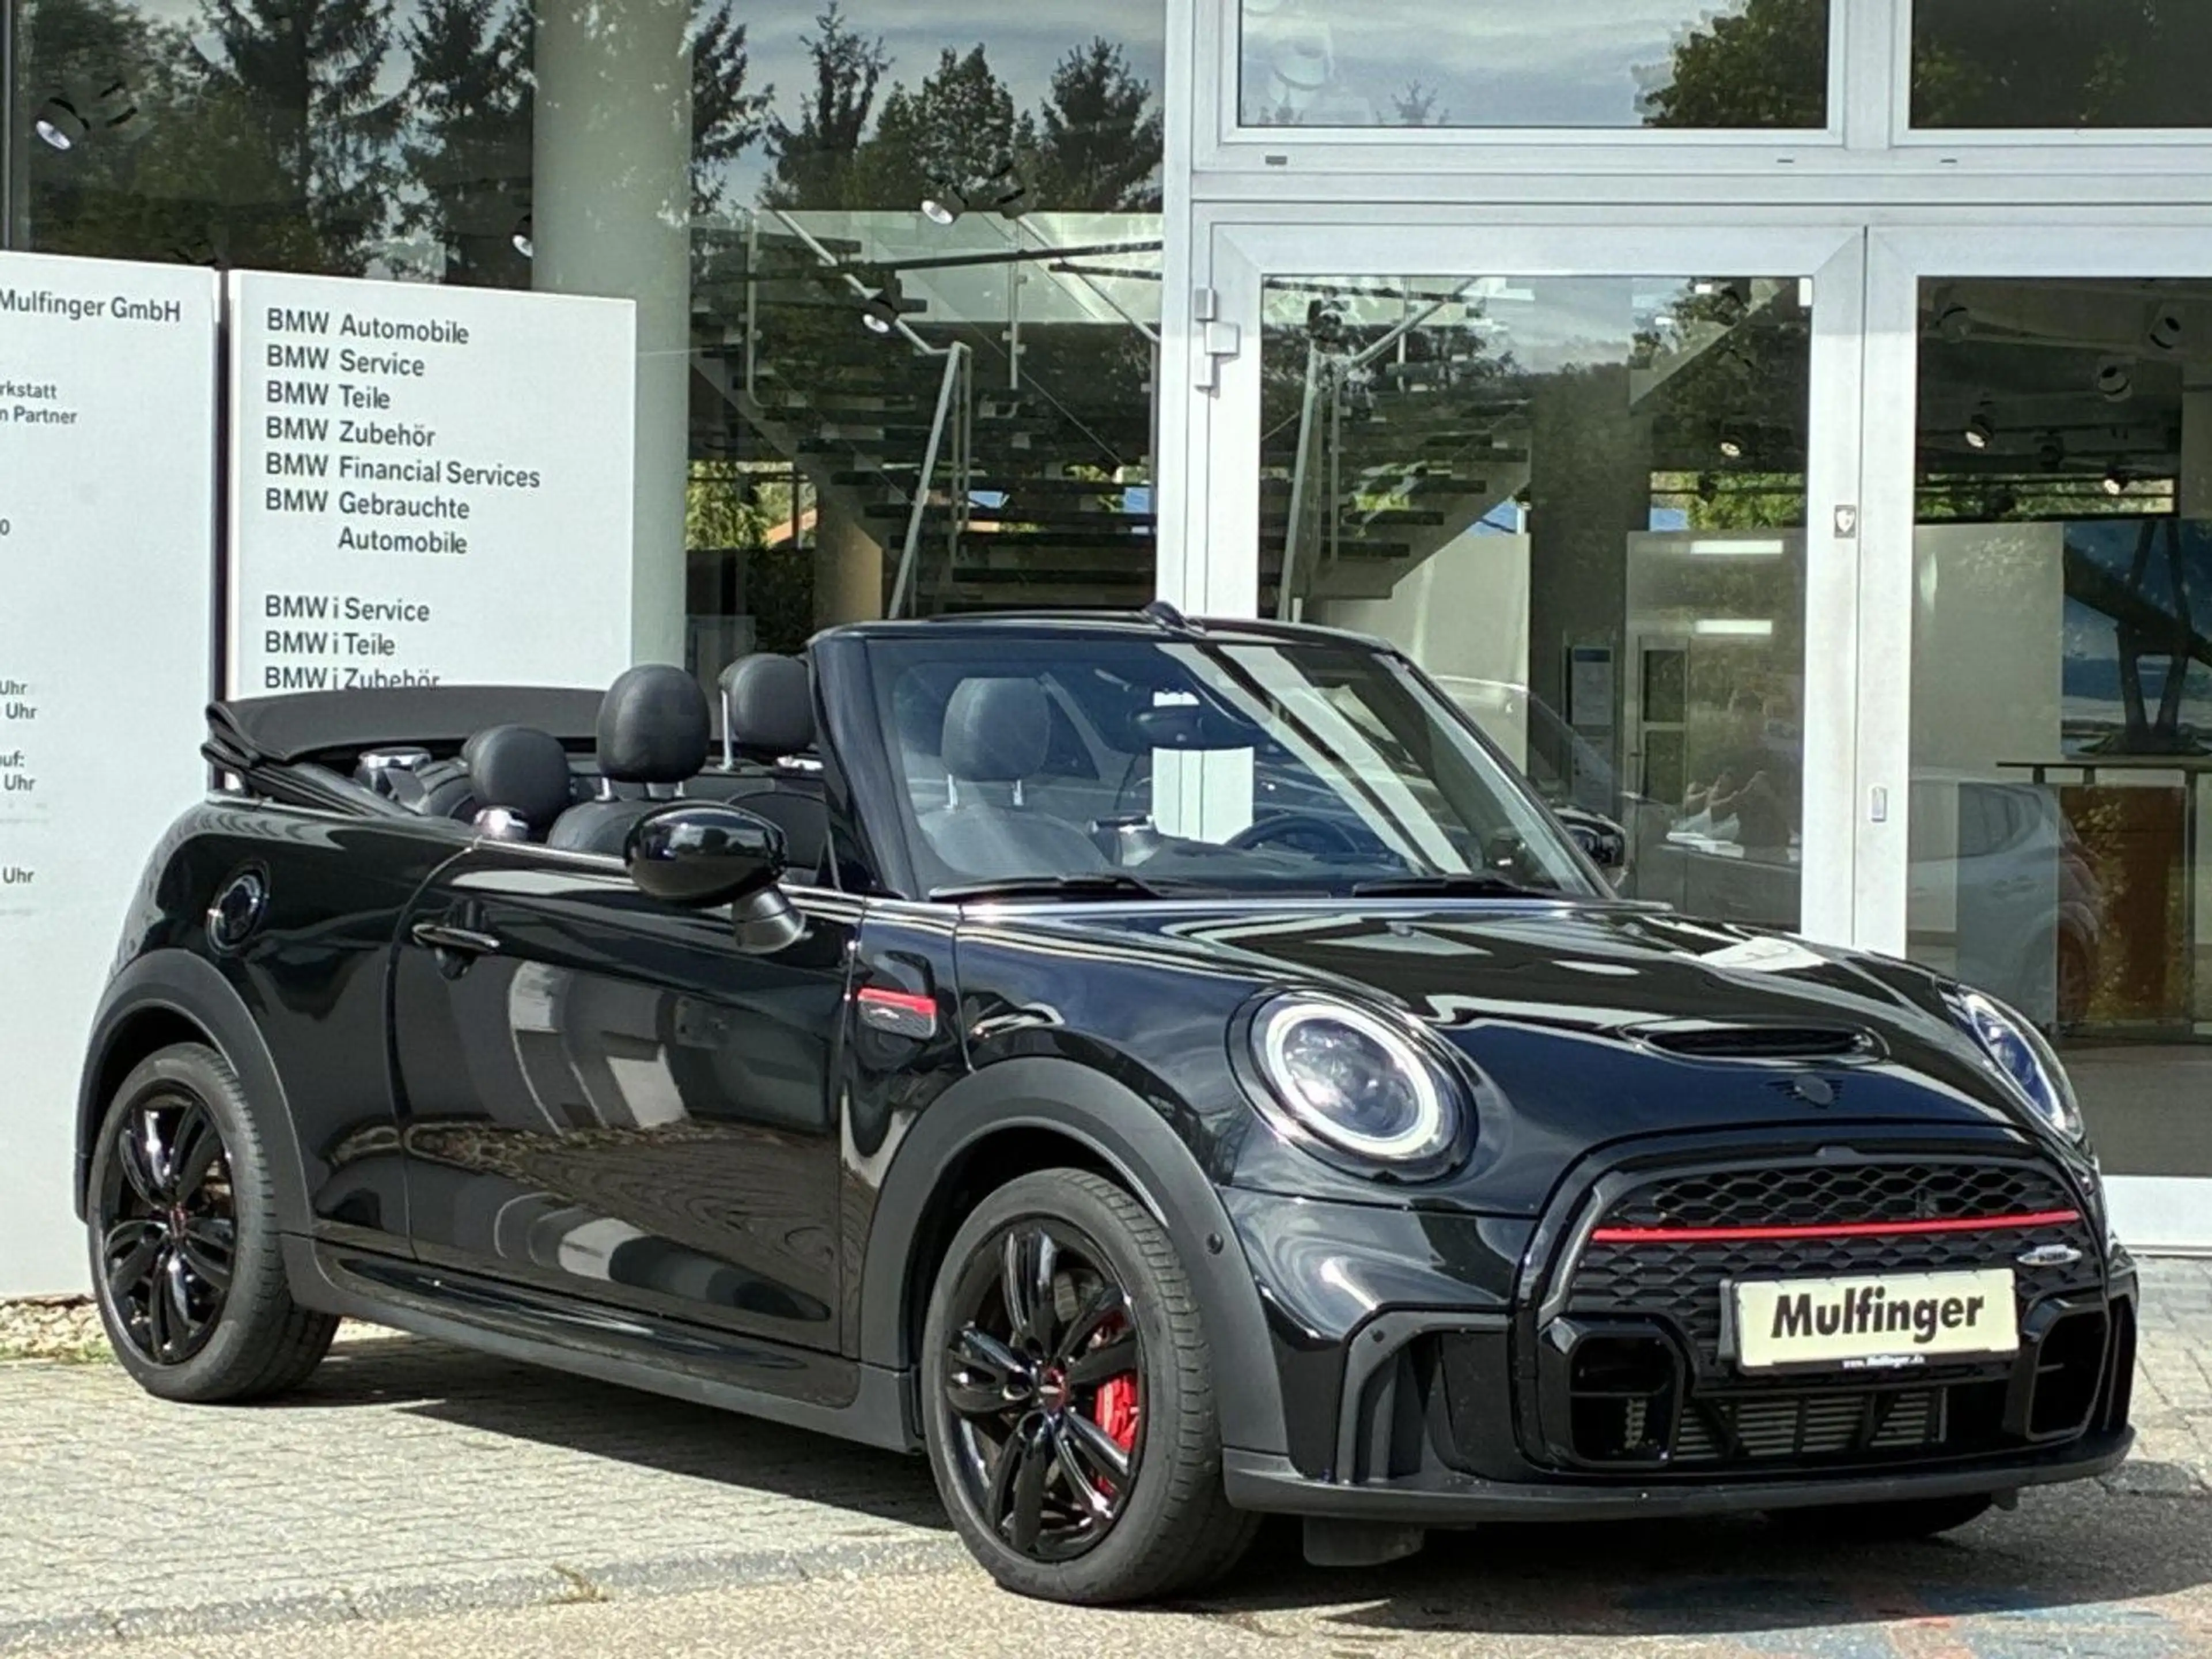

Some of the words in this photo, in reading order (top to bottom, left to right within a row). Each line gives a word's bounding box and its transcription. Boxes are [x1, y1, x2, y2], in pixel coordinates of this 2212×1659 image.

[0, 288, 106, 321] Mulfinger
[110, 296, 181, 323] GmbH
[267, 306, 330, 335] BMW
[339, 313, 470, 346] Automobile
[266, 343, 330, 371] BMW
[339, 348, 425, 377] Service
[266, 379, 330, 407] BMW
[338, 383, 391, 411] Teile
[13, 404, 78, 425] Partner
[266, 415, 329, 442] BMW
[338, 419, 437, 448] Zubehör
[266, 451, 329, 478] BMW
[339, 454, 441, 483] Financial
[446, 460, 541, 489] Services
[265, 487, 329, 513] BMW
[338, 490, 471, 520] Gebrauchte
[337, 525, 468, 555] Automobile
[264, 593, 329, 619] BMW
[332, 596, 339, 620] i
[344, 596, 430, 623] Service
[264, 629, 329, 655] BMW
[332, 631, 339, 655] i
[342, 631, 396, 657] Teile
[0, 679, 28, 696] Uhr
[264, 665, 328, 690] BMW
[332, 666, 339, 690] i
[5, 702, 38, 720] Uhr
[3, 773, 36, 791] Uhr
[2, 867, 35, 885] Uhr
[1771, 1285, 1984, 1343] Mulfinger
